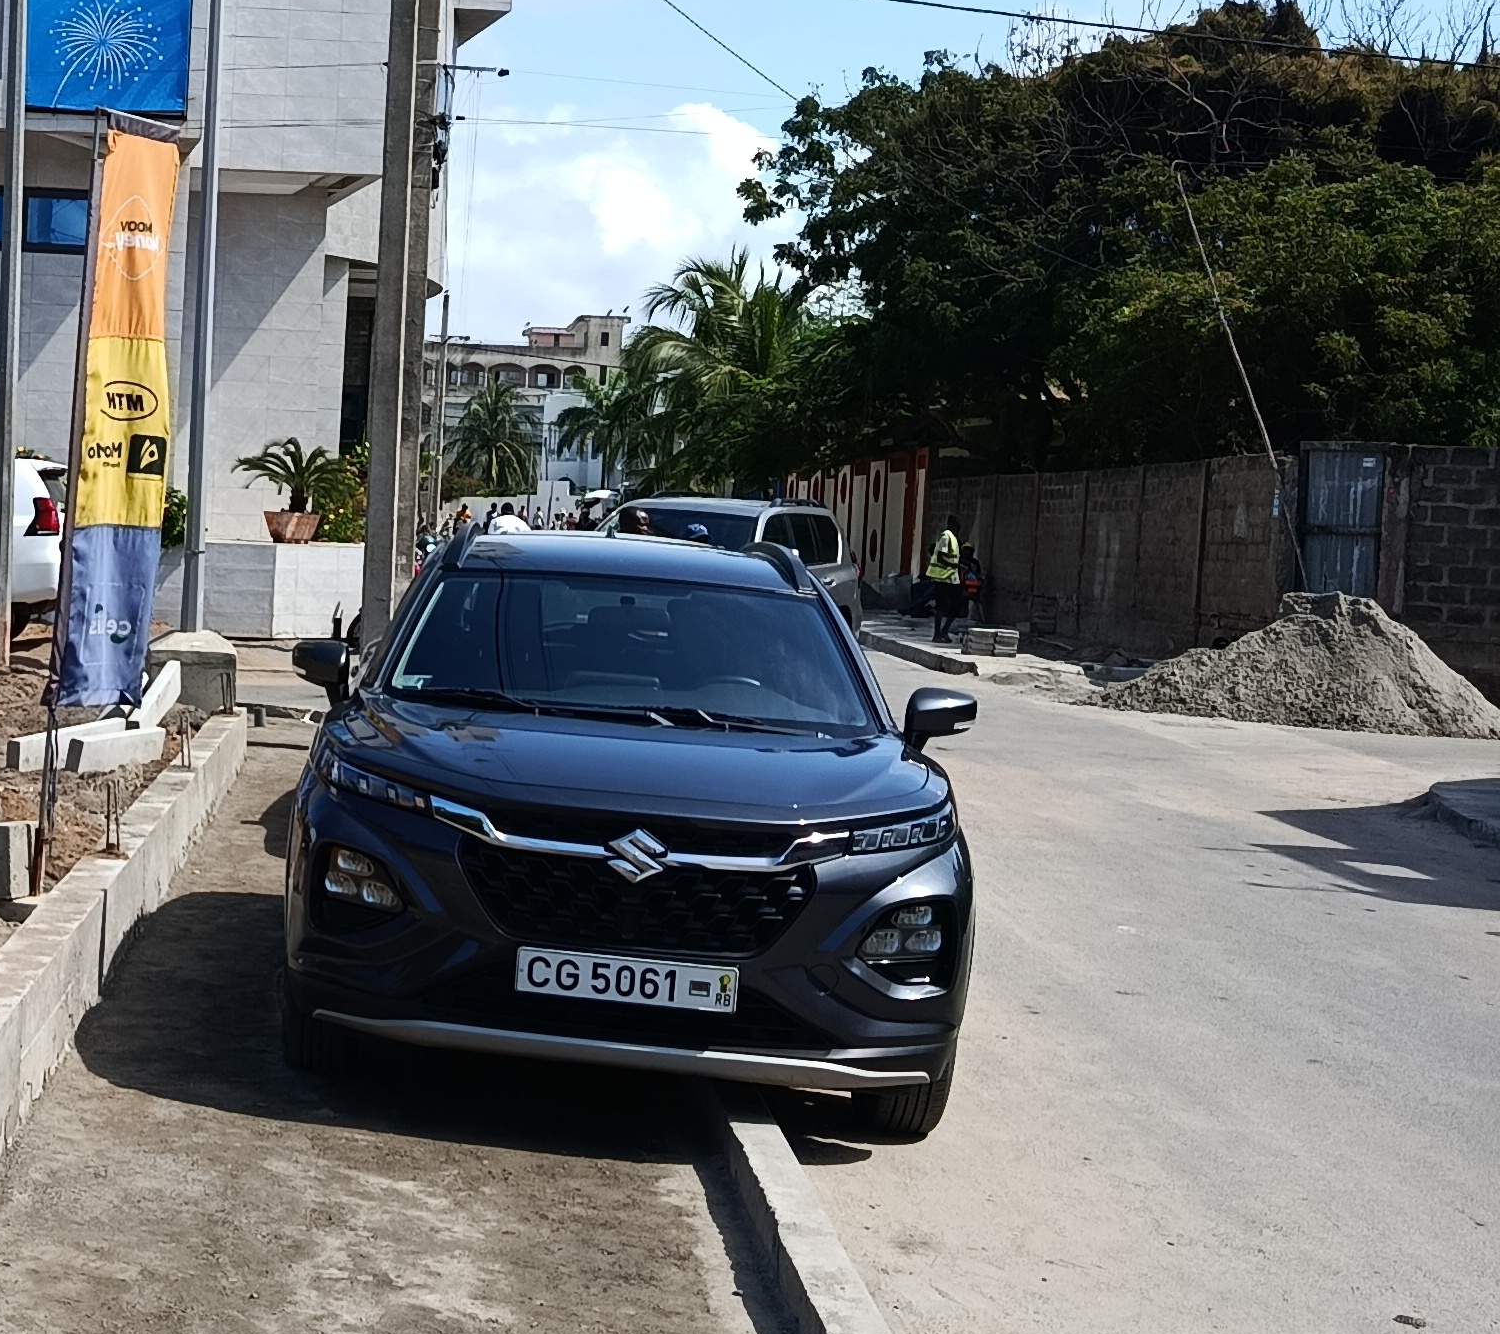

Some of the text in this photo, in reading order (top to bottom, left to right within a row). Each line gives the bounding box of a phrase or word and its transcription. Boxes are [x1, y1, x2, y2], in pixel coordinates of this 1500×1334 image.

[527, 955, 677, 1003] CG 5061
[714, 992, 731, 1008] RB
